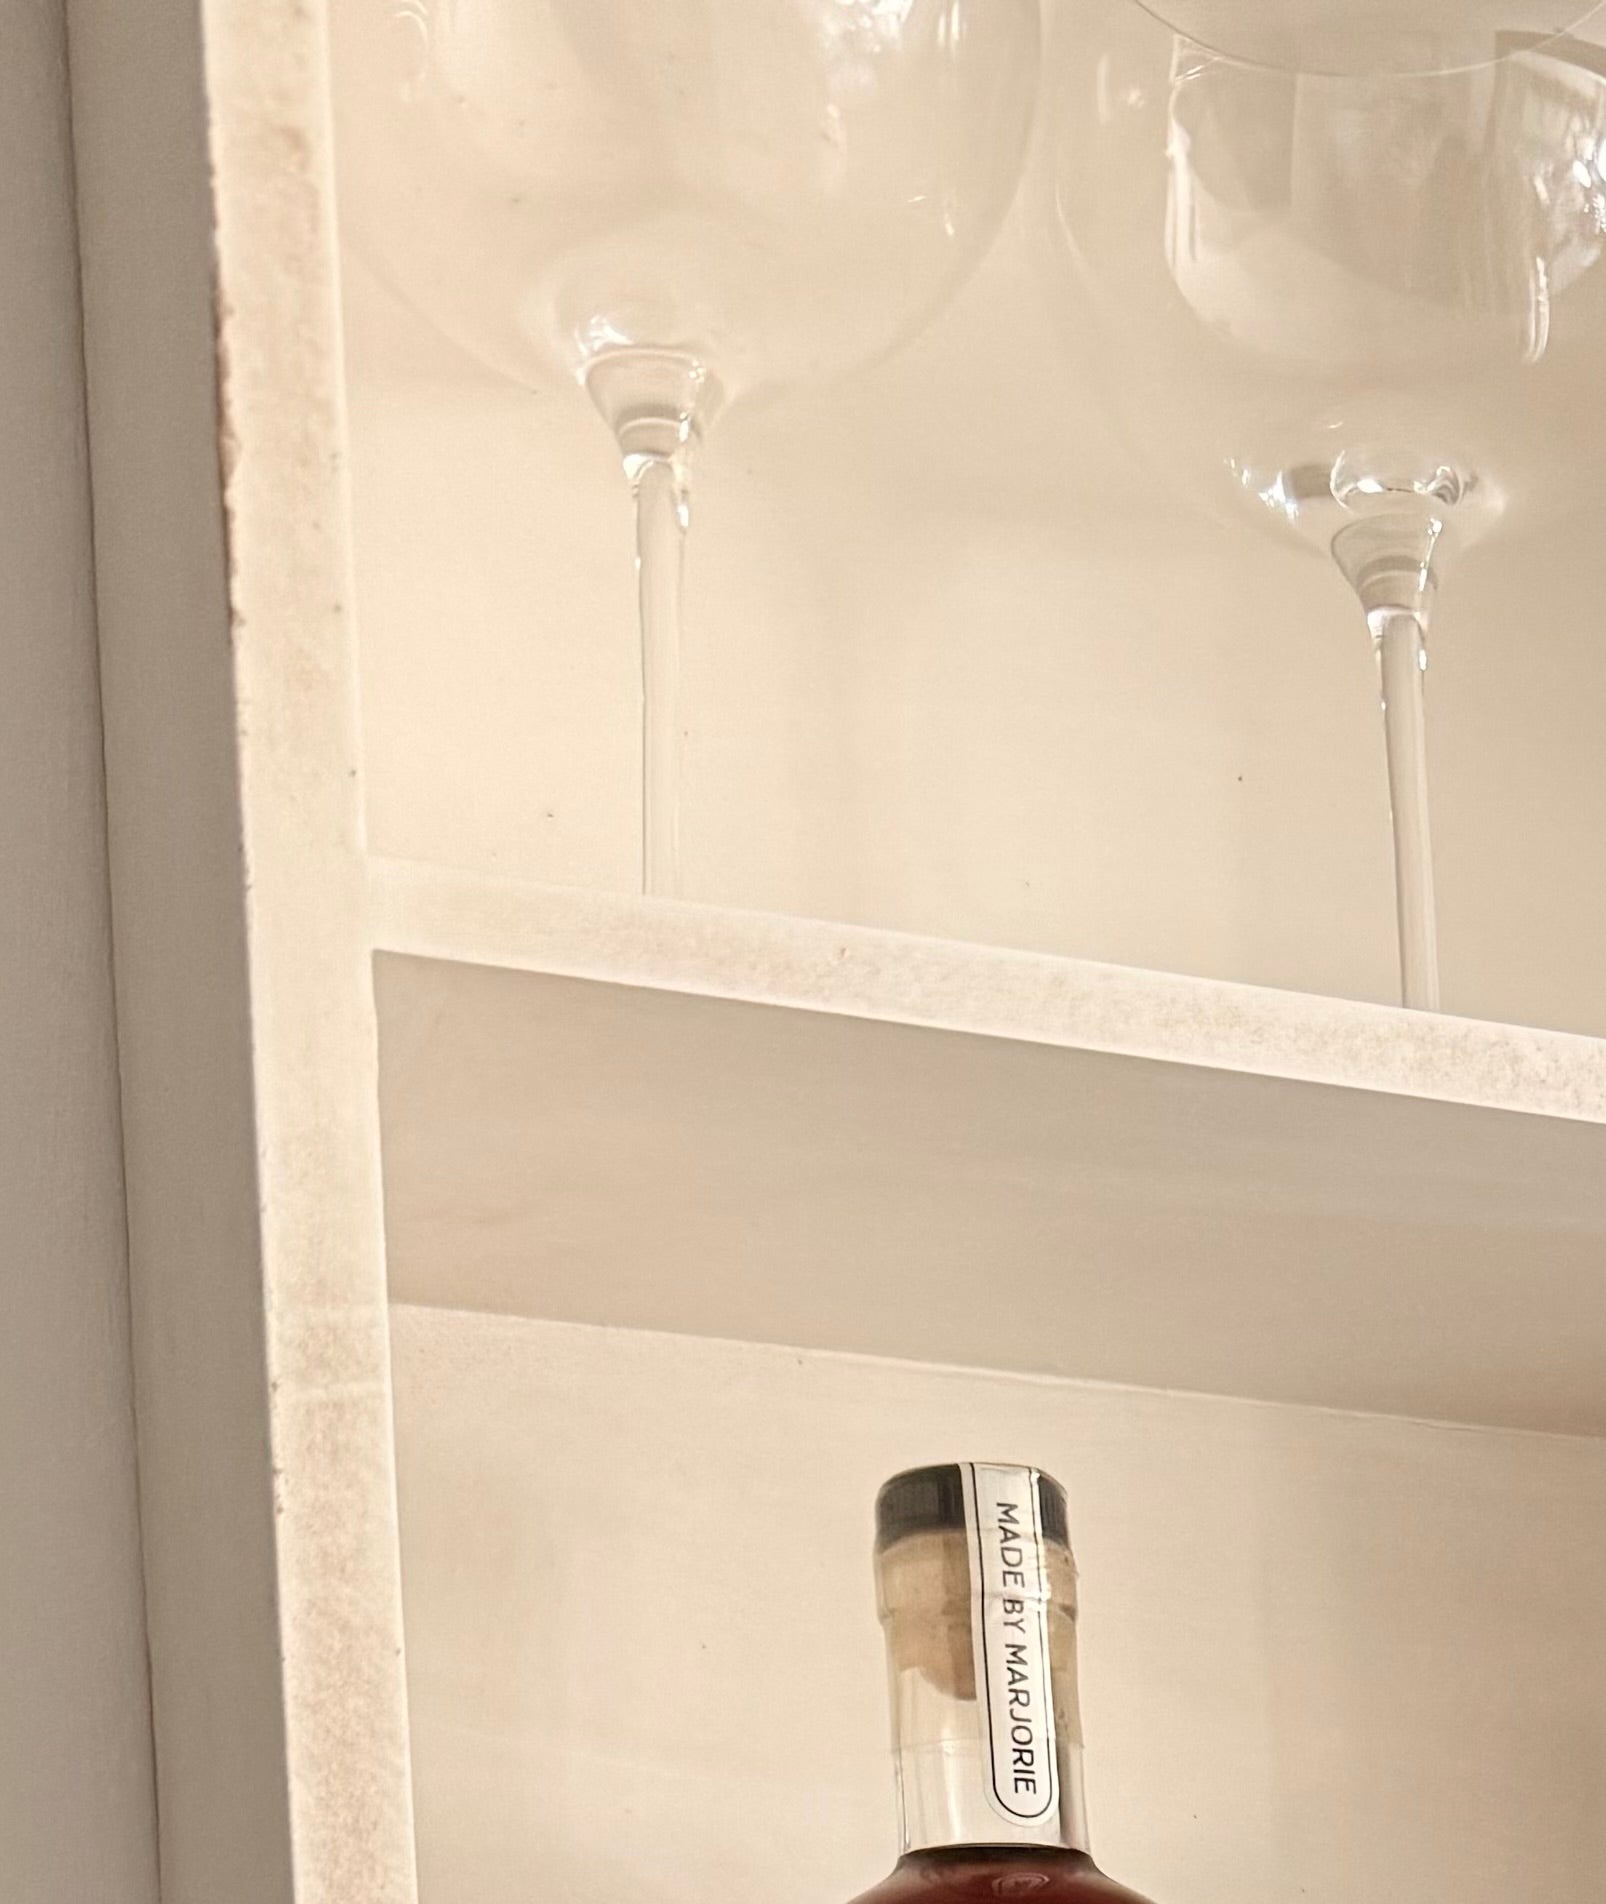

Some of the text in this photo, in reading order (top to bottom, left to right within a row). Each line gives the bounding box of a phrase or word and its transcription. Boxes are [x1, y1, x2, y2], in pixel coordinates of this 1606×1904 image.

[996, 1502, 1037, 1796] MADE BY MARJORIE
